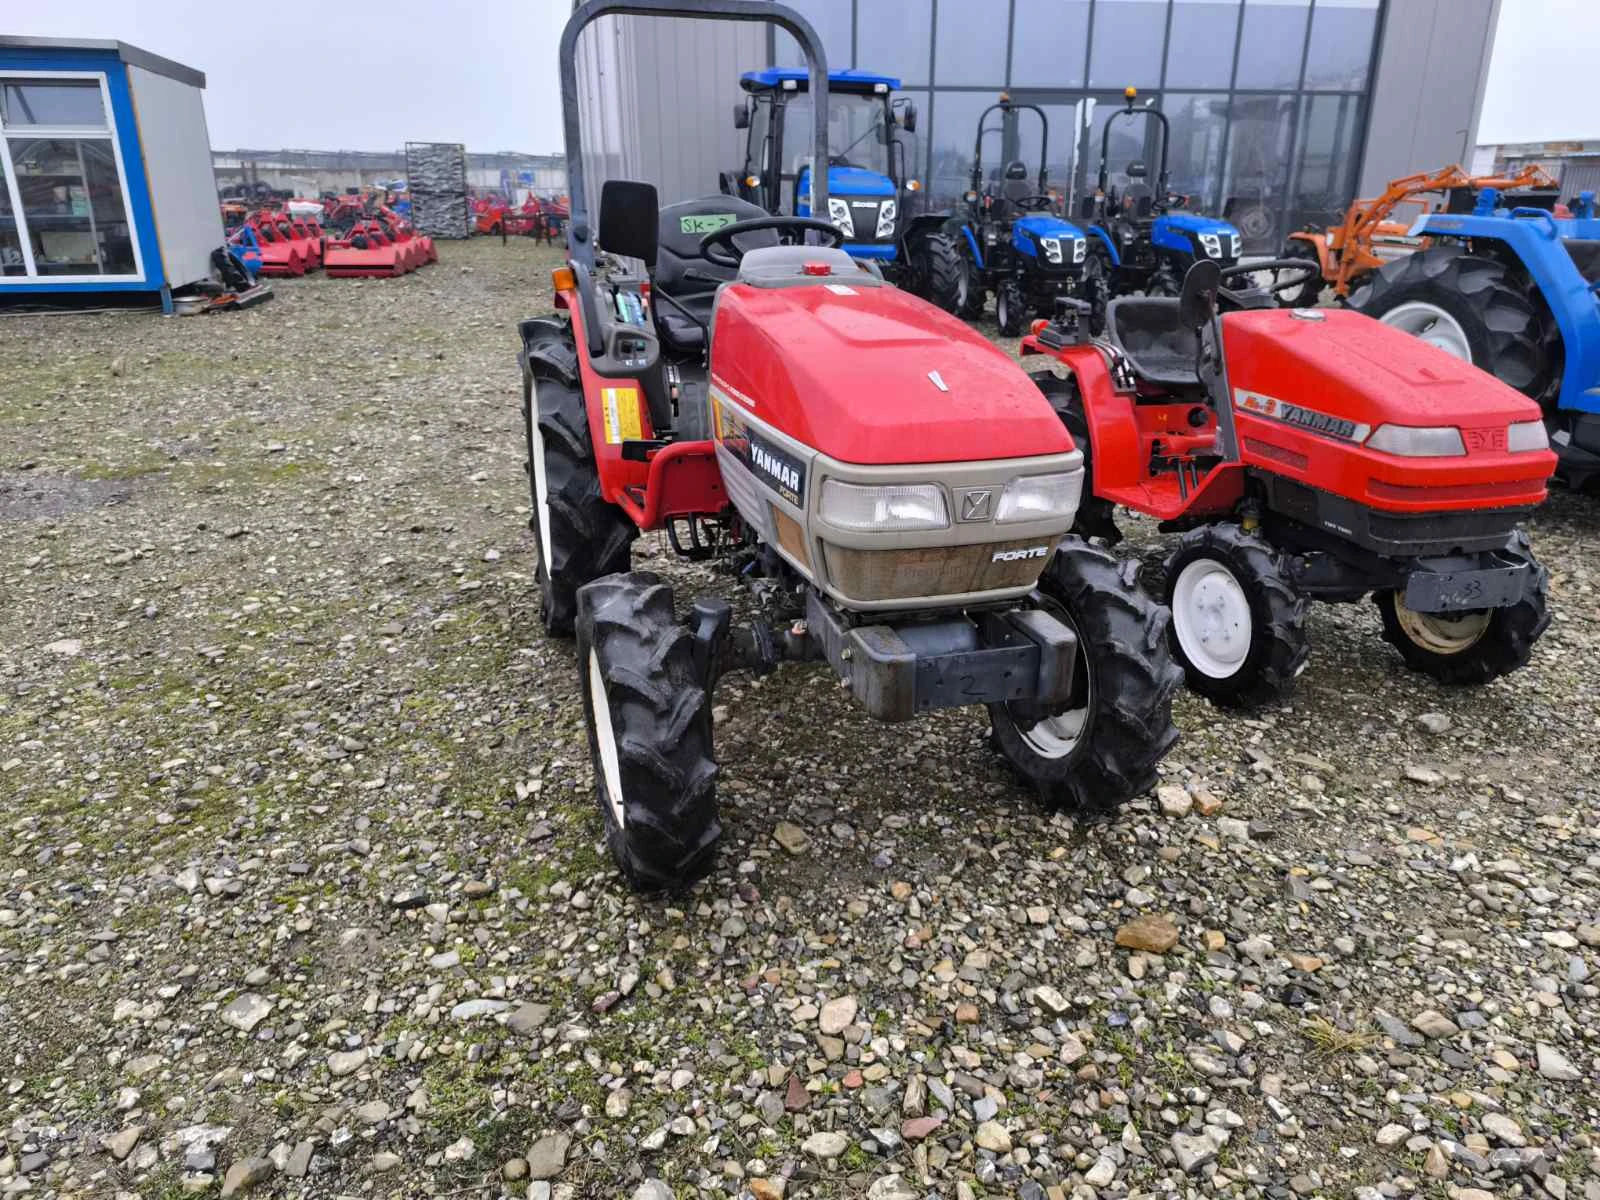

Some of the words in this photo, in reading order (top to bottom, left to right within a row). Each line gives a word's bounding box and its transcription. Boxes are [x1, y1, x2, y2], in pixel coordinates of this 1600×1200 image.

[1279, 403, 1355, 438] YANMAR
[751, 443, 799, 491] YANMAR
[779, 484, 800, 505] FORTE
[992, 547, 1049, 562] FORTE
